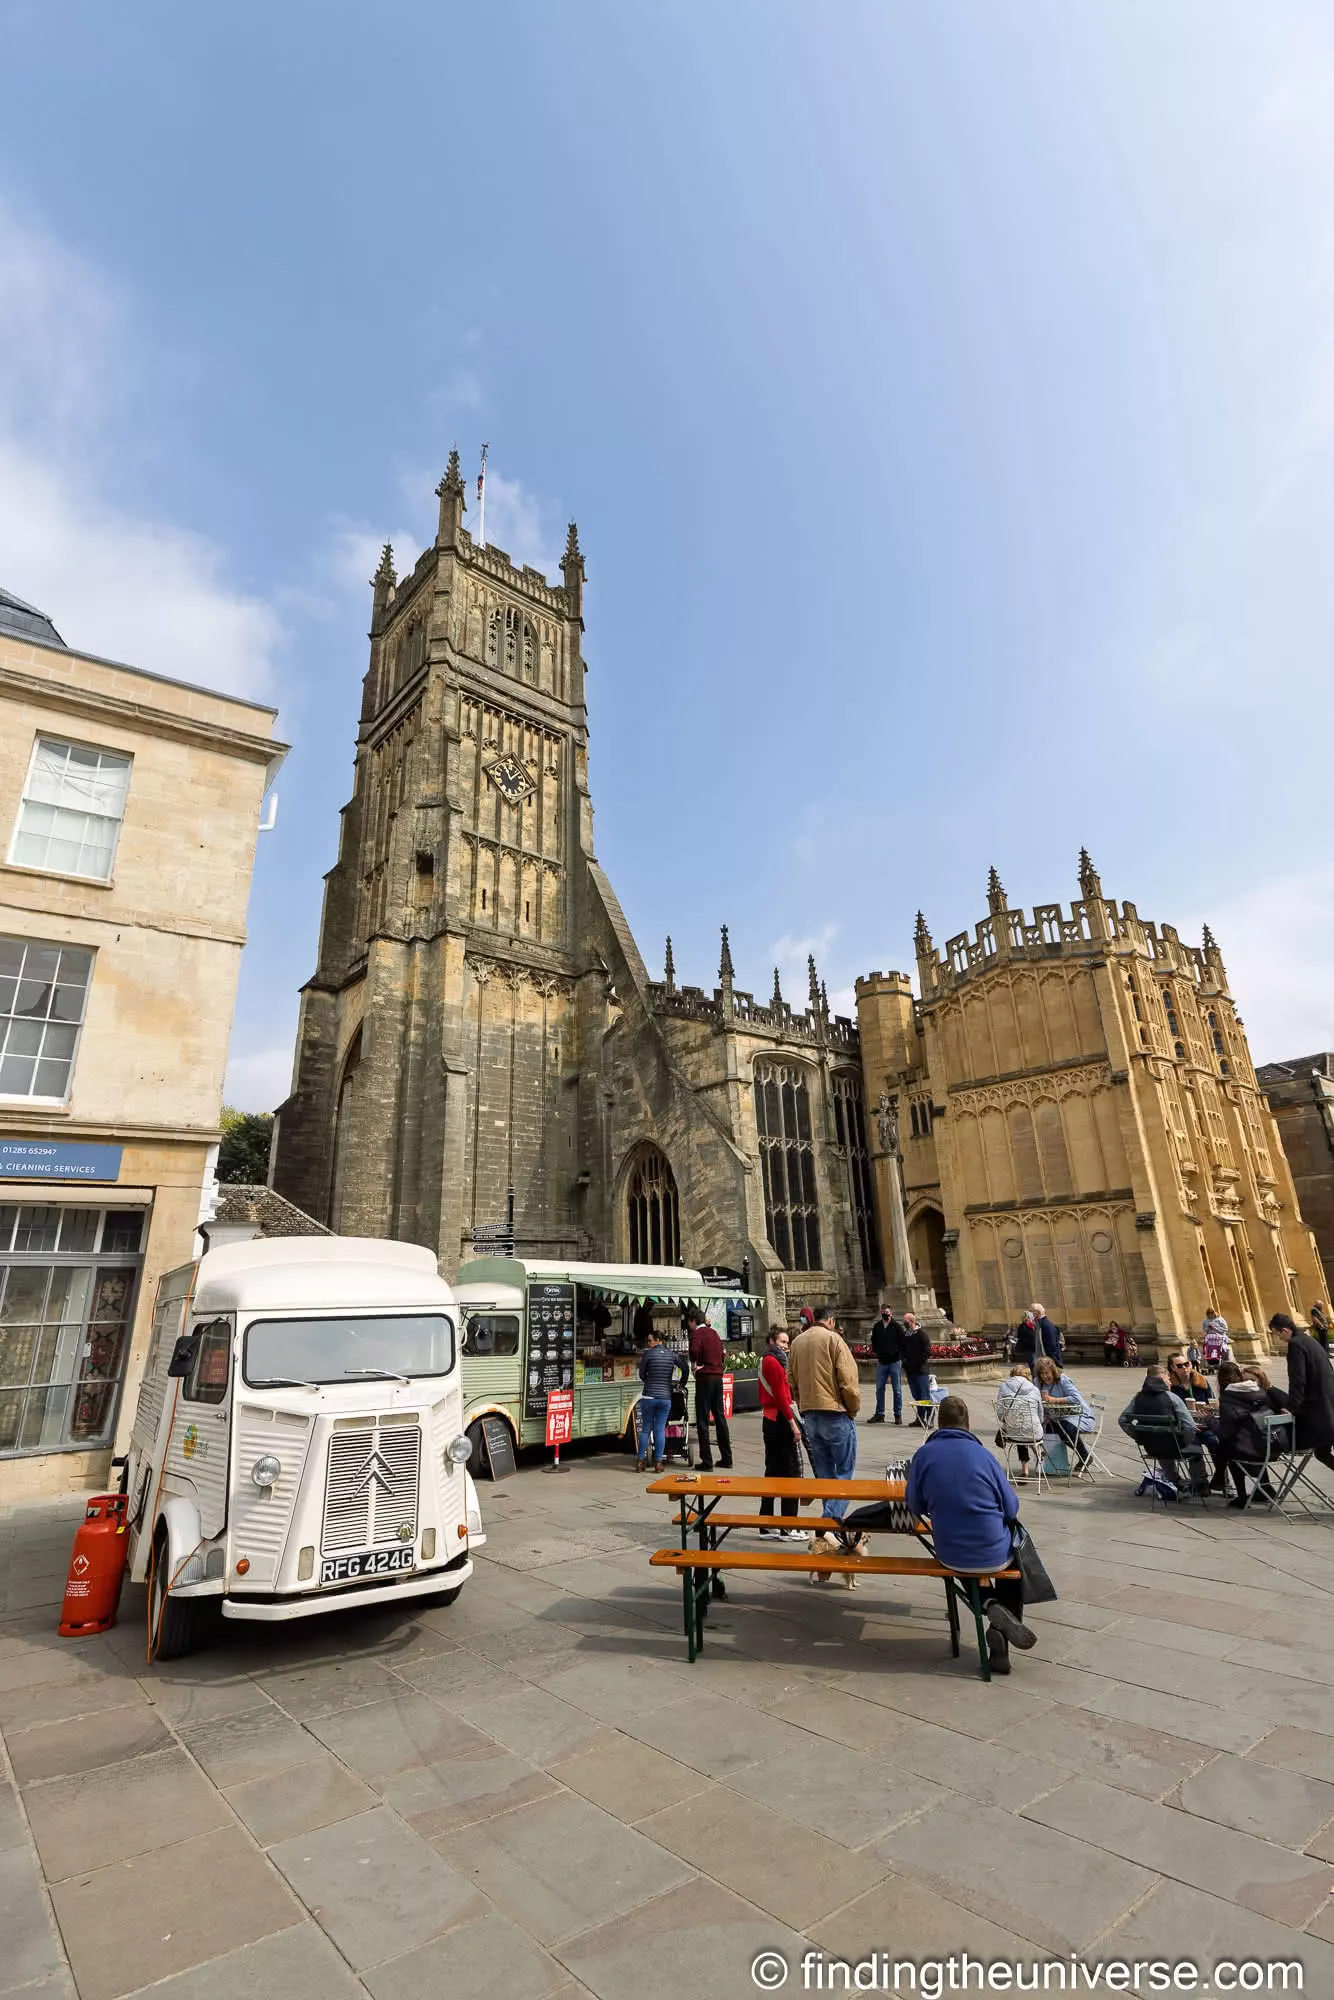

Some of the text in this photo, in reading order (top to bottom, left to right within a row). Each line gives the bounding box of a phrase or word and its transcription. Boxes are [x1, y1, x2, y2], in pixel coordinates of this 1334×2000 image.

[2, 1146, 57, 1156] 01285 652947
[54, 1165, 96, 1174] SERVICES
[322, 1549, 413, 1581] RFG 424G
